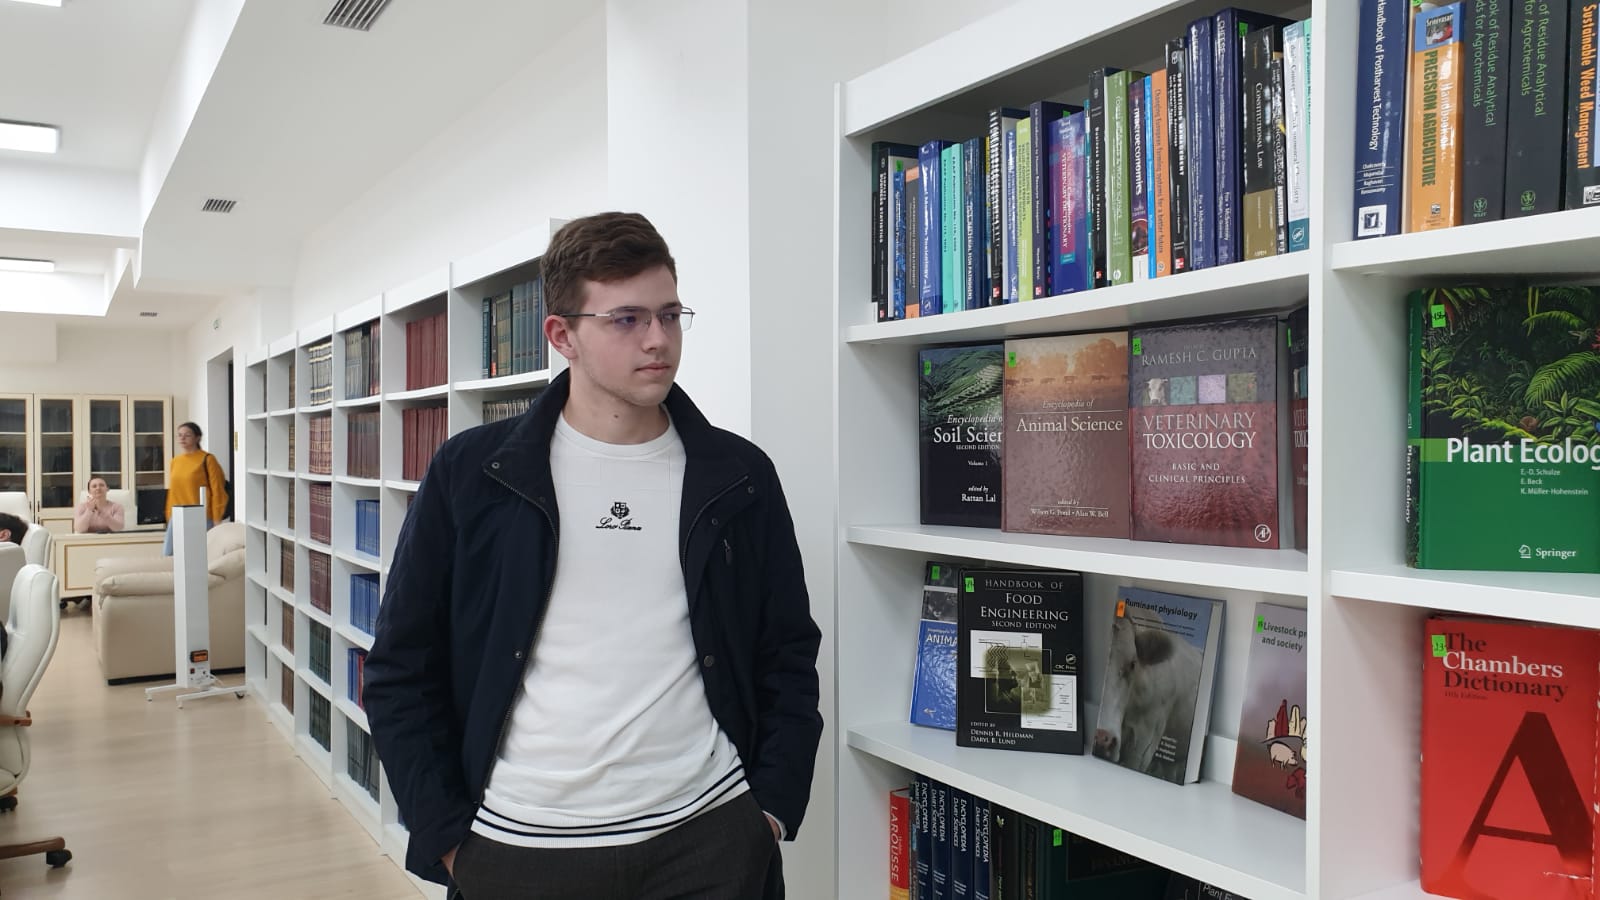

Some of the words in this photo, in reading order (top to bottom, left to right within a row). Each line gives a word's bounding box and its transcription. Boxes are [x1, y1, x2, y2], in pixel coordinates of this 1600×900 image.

[1524, 0, 1535, 15] for
[1537, 4, 1549, 15] of
[1476, 15, 1486, 30] for
[1489, 19, 1499, 30] of
[1536, 18, 1549, 61] Residue
[1581, 4, 1597, 66] Sustainable
[1487, 32, 1499, 73] Residue
[1520, 19, 1536, 97] Agrochemicals
[1472, 32, 1486, 107] Agrochemicals
[1372, 55, 1384, 104] Postharvest
[1423, 50, 1439, 111] PRECISION
[1579, 68, 1595, 99] Weed
[1533, 63, 1548, 117] Analytical
[1440, 82, 1454, 131] Handbook
[1484, 75, 1498, 126] Analytical
[1368, 105, 1381, 151] Technology
[1574, 102, 1594, 169] Management
[1133, 108, 1143, 196] macroeconomics
[1421, 113, 1437, 187] AGRICULTURE
[1155, 148, 1163, 172] farming
[1142, 352, 1192, 367] RAMESH
[1196, 351, 1208, 362] C.
[1213, 347, 1257, 361] GUPTA
[1042, 400, 1085, 410] Encyclopedia
[1086, 399, 1095, 408] of
[947, 414, 996, 426] Encyclopedia
[1016, 416, 1067, 432] Animal
[1071, 415, 1123, 432] Science
[1143, 411, 1257, 430] VETERINARY
[933, 426, 962, 444] Soil
[1143, 431, 1257, 449] TOXICOLOGY
[1447, 437, 1514, 463] Plant
[1172, 463, 1197, 471] BASIC
[1200, 462, 1220, 470] AND
[1536, 468, 1560, 476] Schulze
[1148, 474, 1191, 483] CLINICAL
[1193, 475, 1246, 484] PRINCIPLES
[1527, 477, 1543, 485] Beck
[961, 494, 984, 502] Rattan
[985, 494, 997, 502] Lal
[1528, 486, 1589, 496] Müller-Hohenstein
[1535, 547, 1577, 559] Springer
[985, 578, 1044, 590] HANDBOOK
[1050, 581, 1064, 590] OF
[1005, 592, 1043, 605] FOOD
[980, 606, 1069, 622] ENGINEERING
[1158, 604, 1198, 620] physiology
[992, 620, 1021, 628] SECOND
[1025, 621, 1057, 630] EDITION
[1263, 621, 1298, 637] Livestock
[1261, 636, 1276, 646] and
[1277, 639, 1303, 653] society
[1443, 632, 1487, 652] The
[1442, 651, 1563, 678] Chambers
[1444, 670, 1568, 703] Dictionary
[970, 729, 994, 737] DENNIS
[970, 736, 990, 744] DARYL
[890, 806, 899, 882] LAROUSSE
